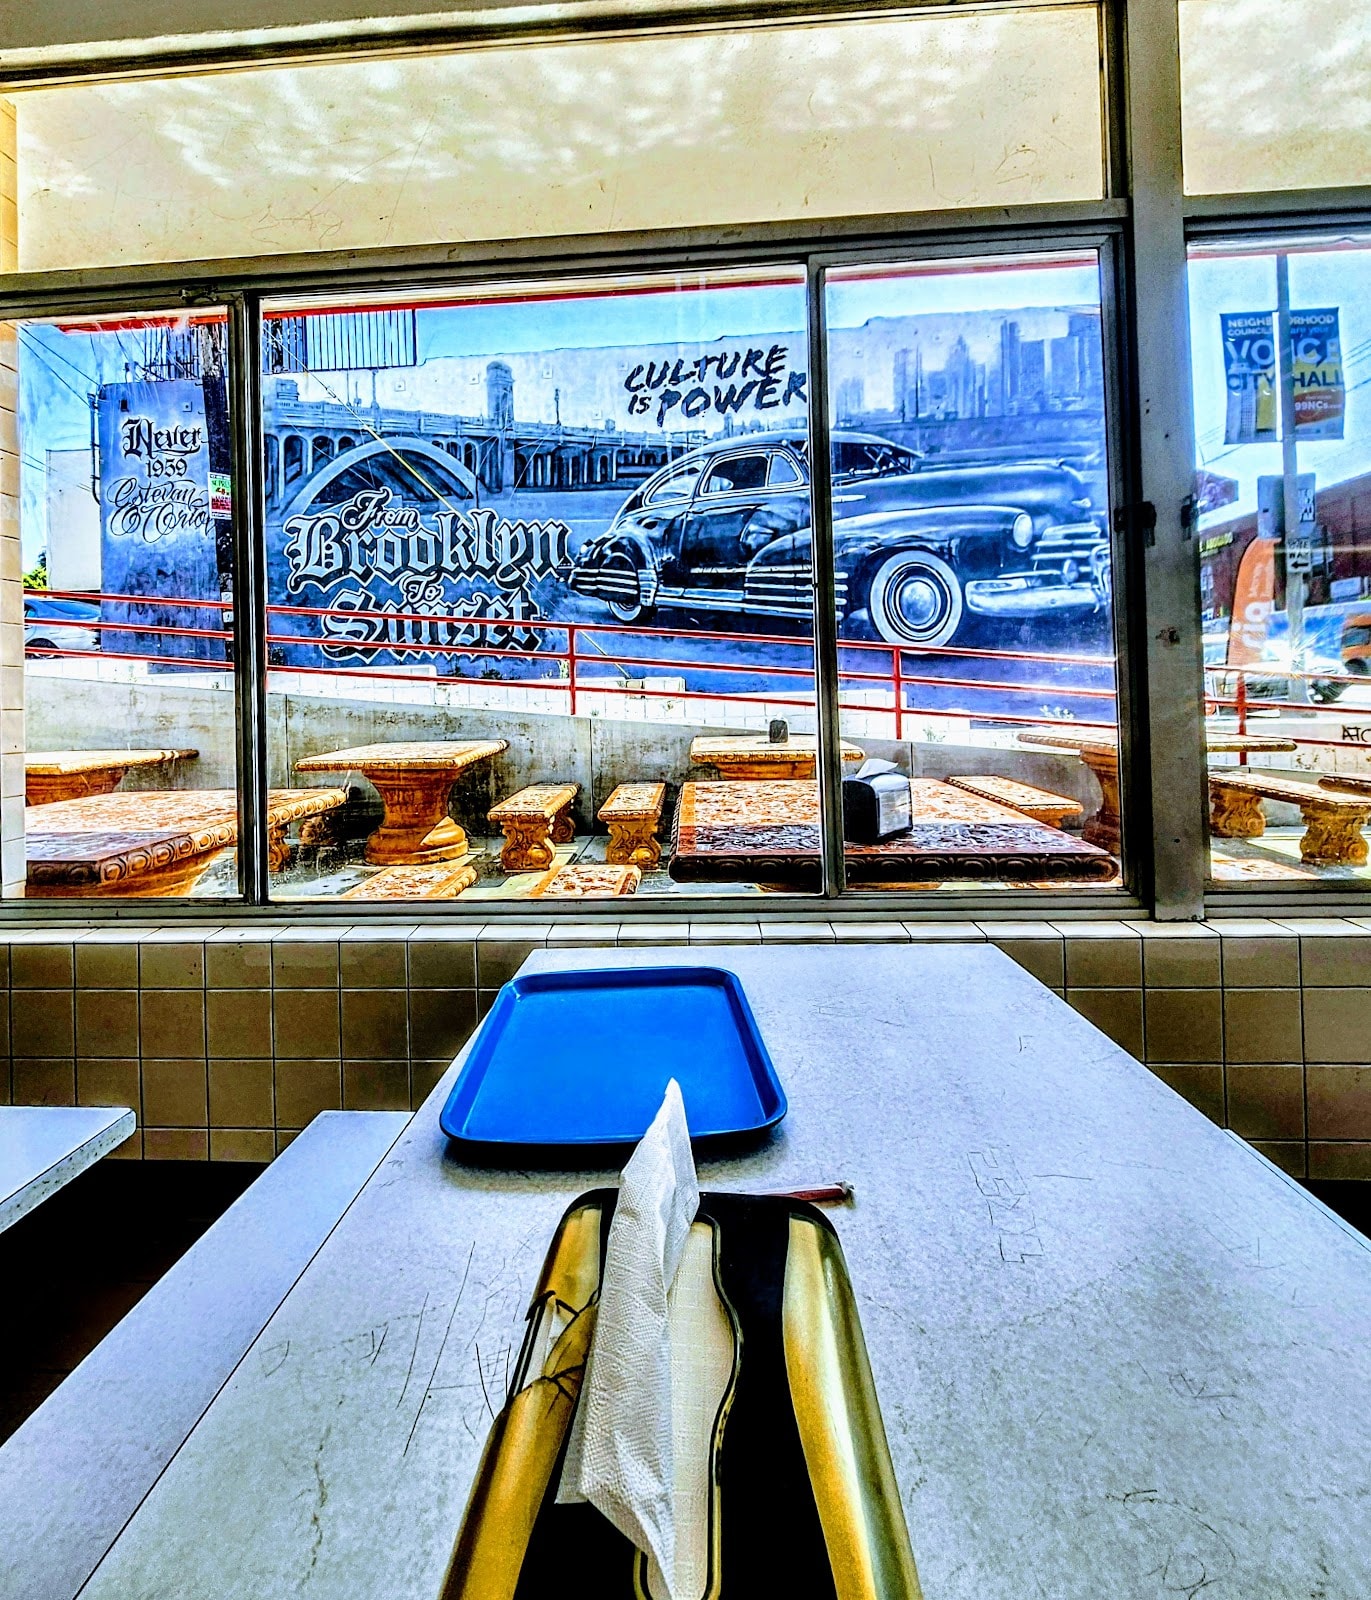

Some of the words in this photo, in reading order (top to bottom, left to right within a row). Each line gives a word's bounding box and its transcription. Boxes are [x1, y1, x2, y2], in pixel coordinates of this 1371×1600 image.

[624, 344, 789, 393] CULTURE
[657, 371, 807, 428] POWER
[121, 416, 201, 460] Never
[146, 458, 188, 478] 1959
[341, 487, 420, 532] From
[284, 508, 575, 594] Brooklyn
[400, 572, 444, 602] To
[321, 588, 542, 664] Sunset
